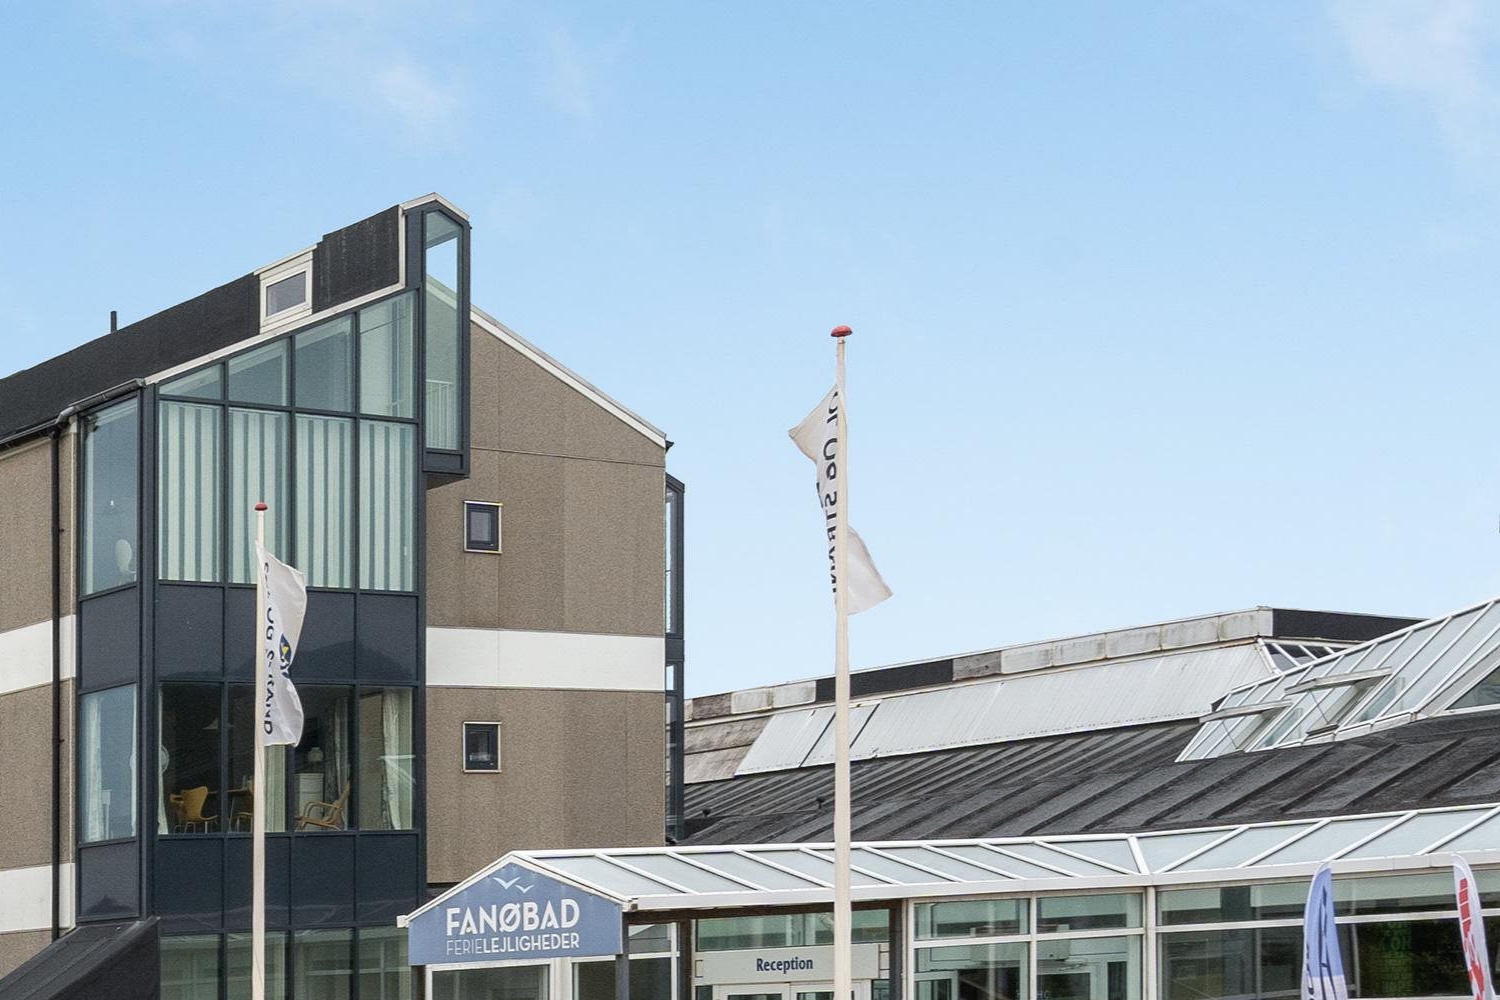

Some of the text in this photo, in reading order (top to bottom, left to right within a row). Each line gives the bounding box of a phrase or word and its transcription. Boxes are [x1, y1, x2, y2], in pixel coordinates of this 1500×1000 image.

[446, 899, 580, 936] FANØBAD
[446, 932, 580, 955] FERIELEJLIGHEDER
[756, 956, 813, 974] Reception
